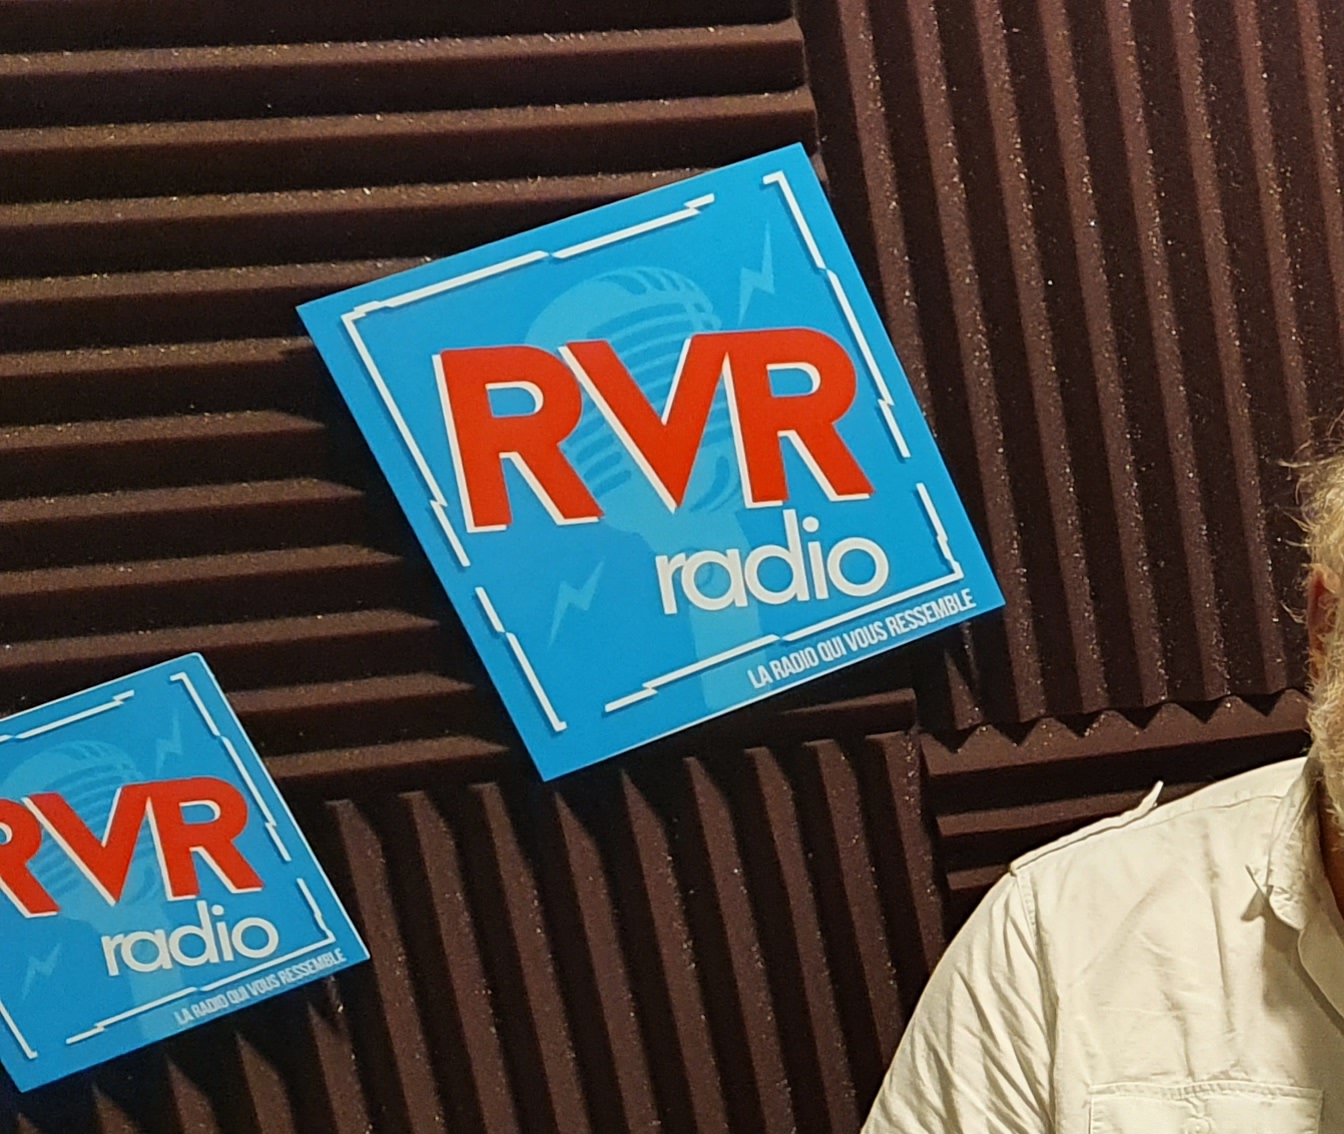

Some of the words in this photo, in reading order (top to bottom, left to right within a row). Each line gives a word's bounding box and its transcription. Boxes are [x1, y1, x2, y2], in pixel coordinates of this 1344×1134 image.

[432, 327, 875, 532] RVR
[655, 509, 889, 615] radio
[747, 665, 773, 689] LA
[769, 647, 820, 680] RADIO
[818, 633, 847, 662] QUI
[843, 621, 888, 652] VOUS
[885, 588, 977, 638] RESSEMBLE
[101, 900, 279, 977] radio
[174, 1009, 194, 1026] LA
[191, 994, 229, 1019] RADIO
[246, 973, 281, 997] VOUS
[277, 948, 347, 986] RESSEMBLE
